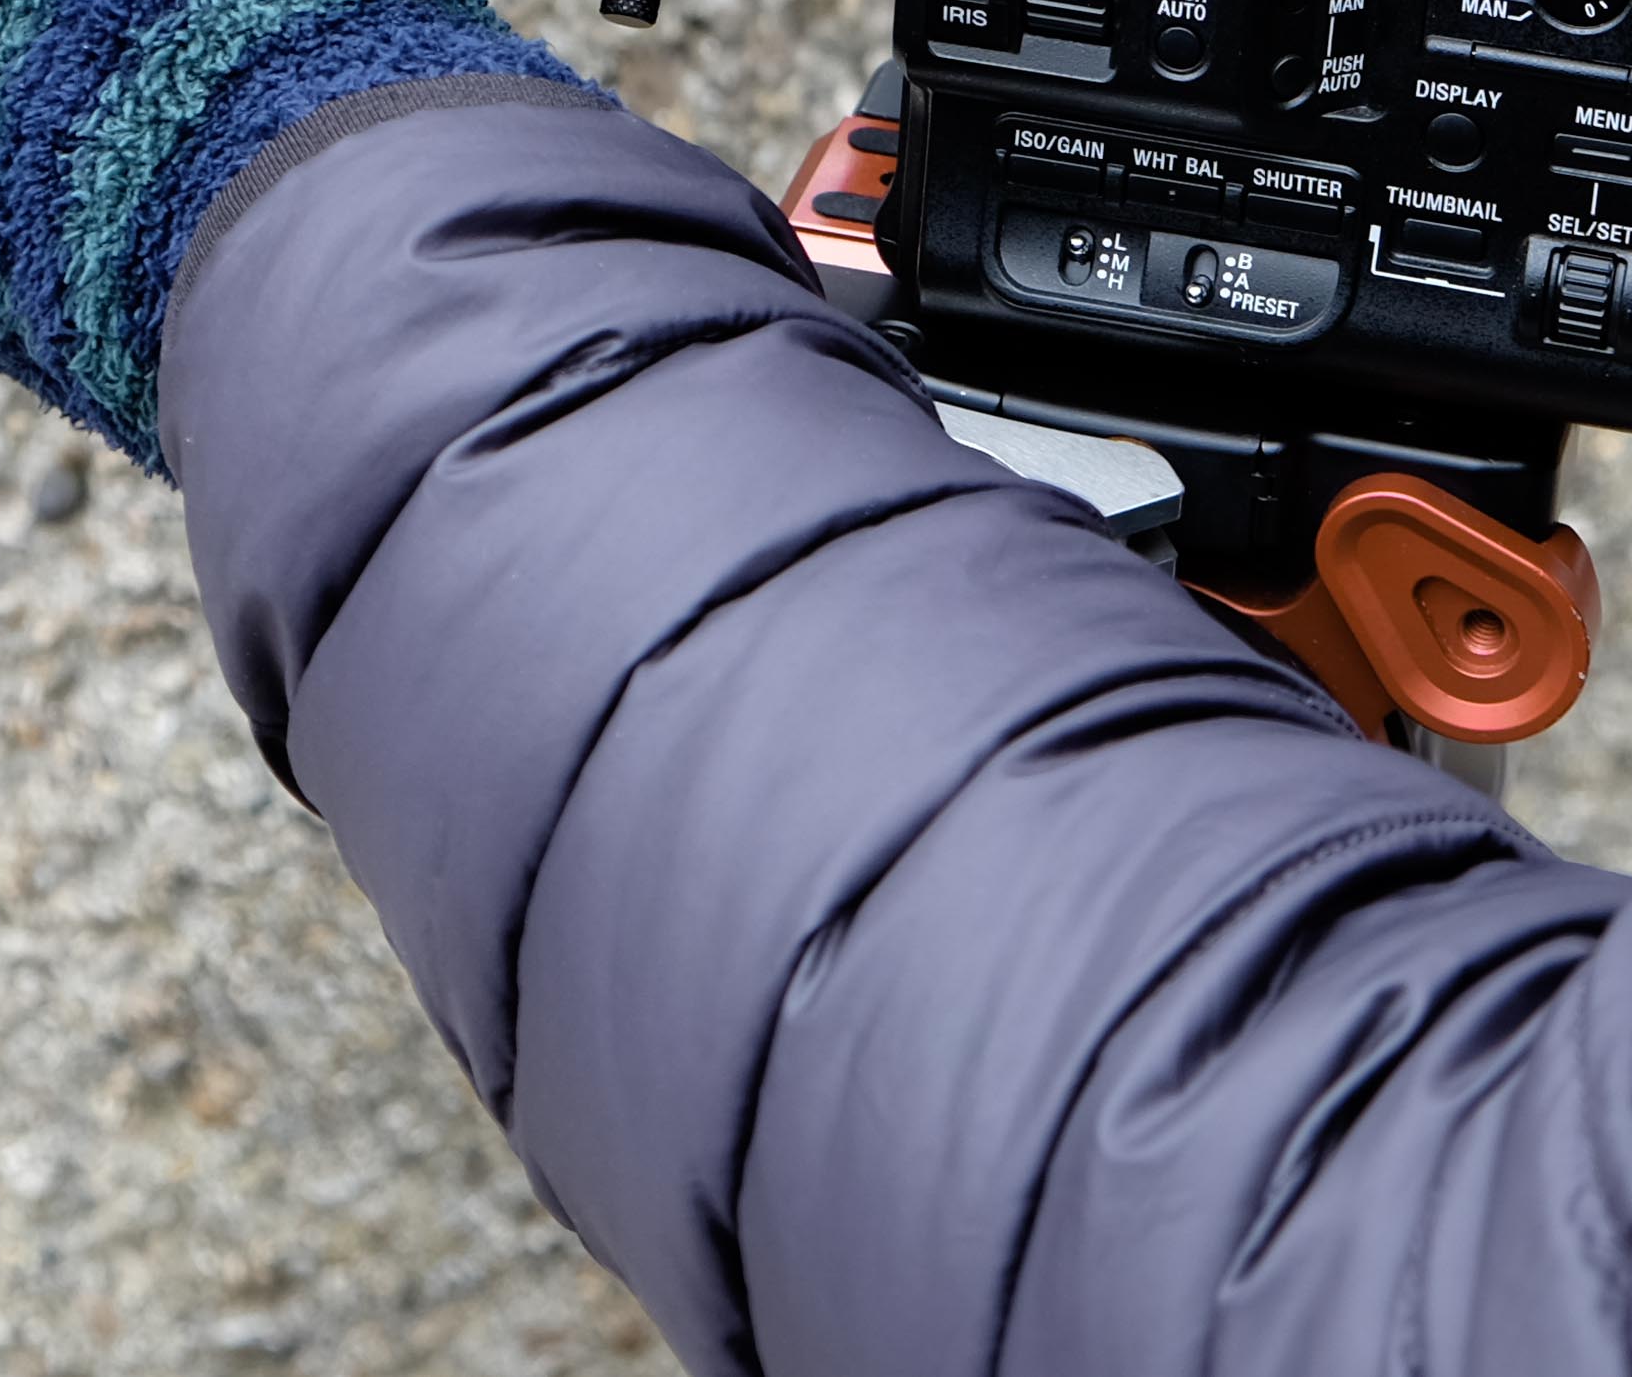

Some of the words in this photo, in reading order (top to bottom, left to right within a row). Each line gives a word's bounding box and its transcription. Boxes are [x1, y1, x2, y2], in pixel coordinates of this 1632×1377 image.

[943, 5, 988, 27] IRIS
[1157, 0, 1207, 21] AUTO
[1322, 55, 1365, 75] PUSH
[1318, 72, 1362, 94] AUTO
[1415, 79, 1503, 110] DISPLAY
[1013, 129, 1105, 160] ISO/GAIN
[1133, 148, 1178, 171] WHT
[1185, 156, 1224, 180] BAL
[1252, 168, 1343, 199] SHUTTER
[1386, 185, 1503, 222] THUMBNAIL
[1114, 233, 1127, 250] L
[1111, 254, 1130, 272] M
[1237, 253, 1253, 270] B
[1108, 273, 1124, 291] H
[1234, 272, 1251, 290] A
[1231, 292, 1299, 319] PRESET
